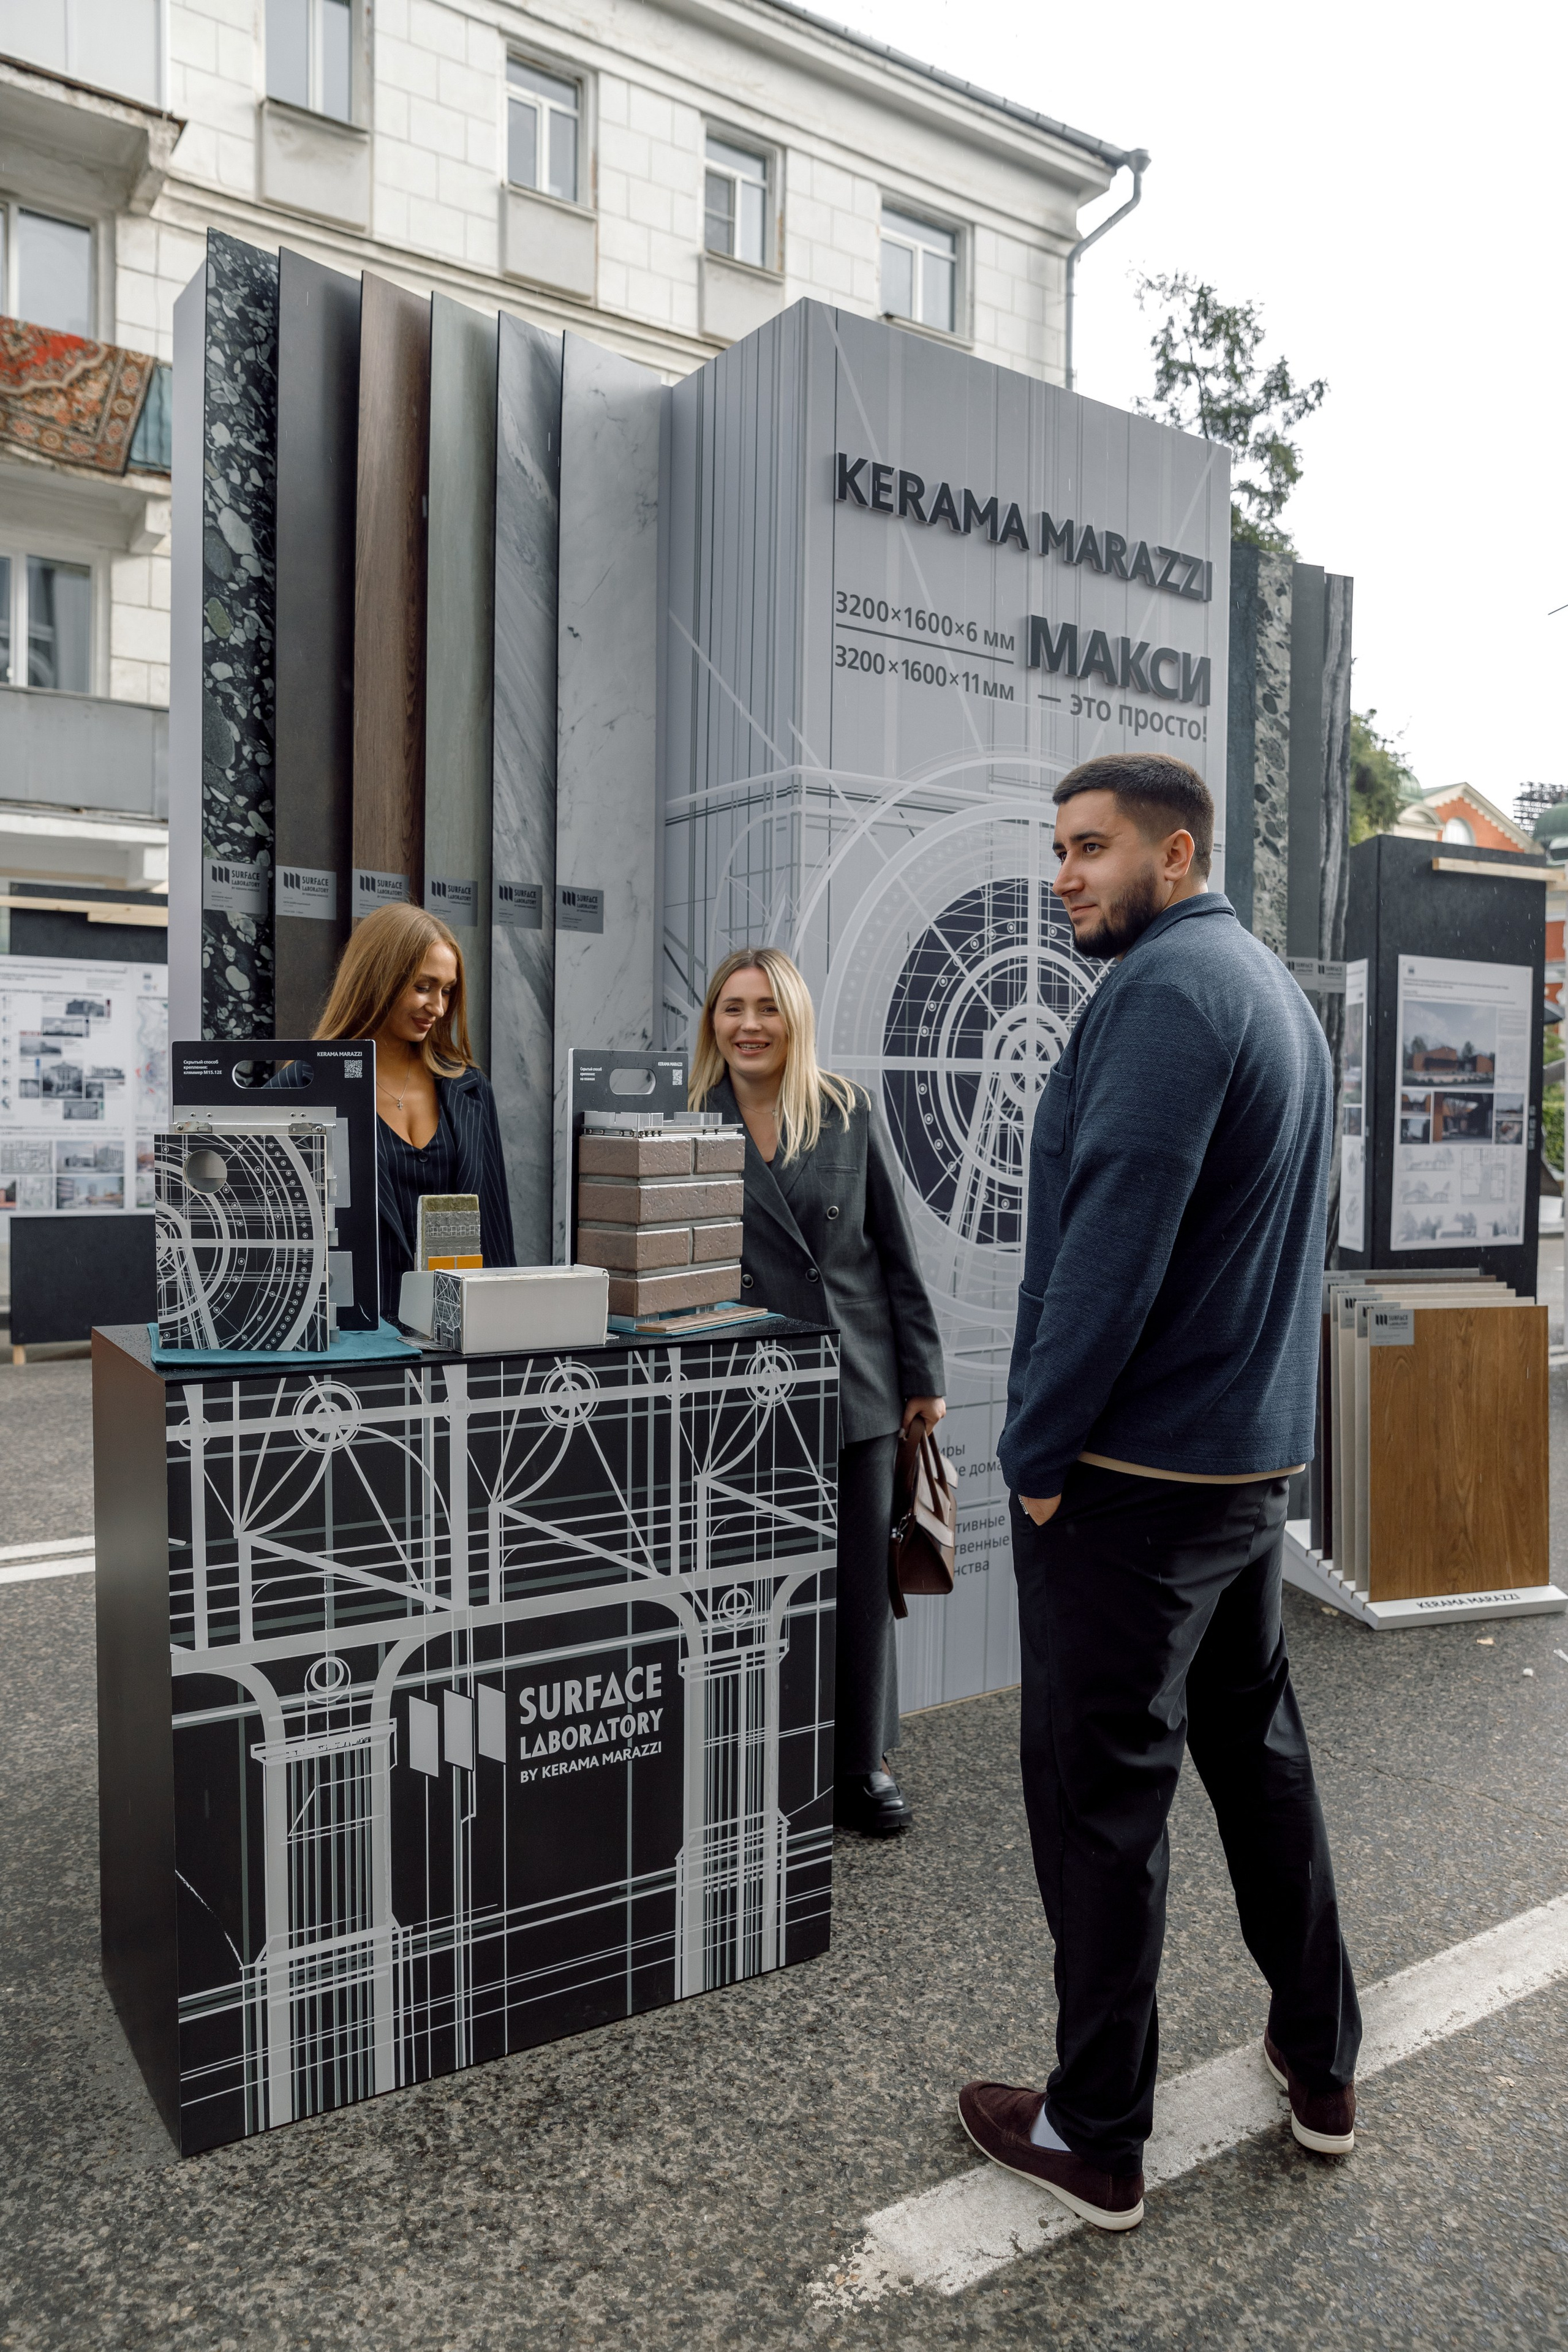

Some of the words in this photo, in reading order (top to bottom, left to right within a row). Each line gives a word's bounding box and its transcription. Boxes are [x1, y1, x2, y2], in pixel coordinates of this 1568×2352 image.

[835, 452, 1030, 551] KERAMA
[1039, 511, 1213, 602] MARAZZI
[1027, 614, 1212, 707] МАКСИ
[1069, 693, 1112, 722] это
[1118, 702, 1208, 743] просто!
[232, 870, 260, 880] SURFACE
[302, 876, 329, 886] SURFACE
[377, 880, 402, 889] SURFACE
[448, 884, 471, 894] SURFACE
[514, 889, 537, 899] SURFACE
[577, 894, 598, 903] SURFACE
[955, 1515, 1005, 1534] тивные
[954, 1536, 1009, 1555] твенные
[954, 1560, 990, 1576] нства
[1416, 1599, 1467, 1609] KERAMA
[1467, 1593, 1521, 1604] MARAZZI
[519, 1663, 662, 1725] SURFACE
[520, 1708, 663, 1760] LABORATORY
[520, 1768, 538, 1784] BY
[541, 1755, 599, 1779] KERAMA
[602, 1741, 662, 1764] MARAZZI
